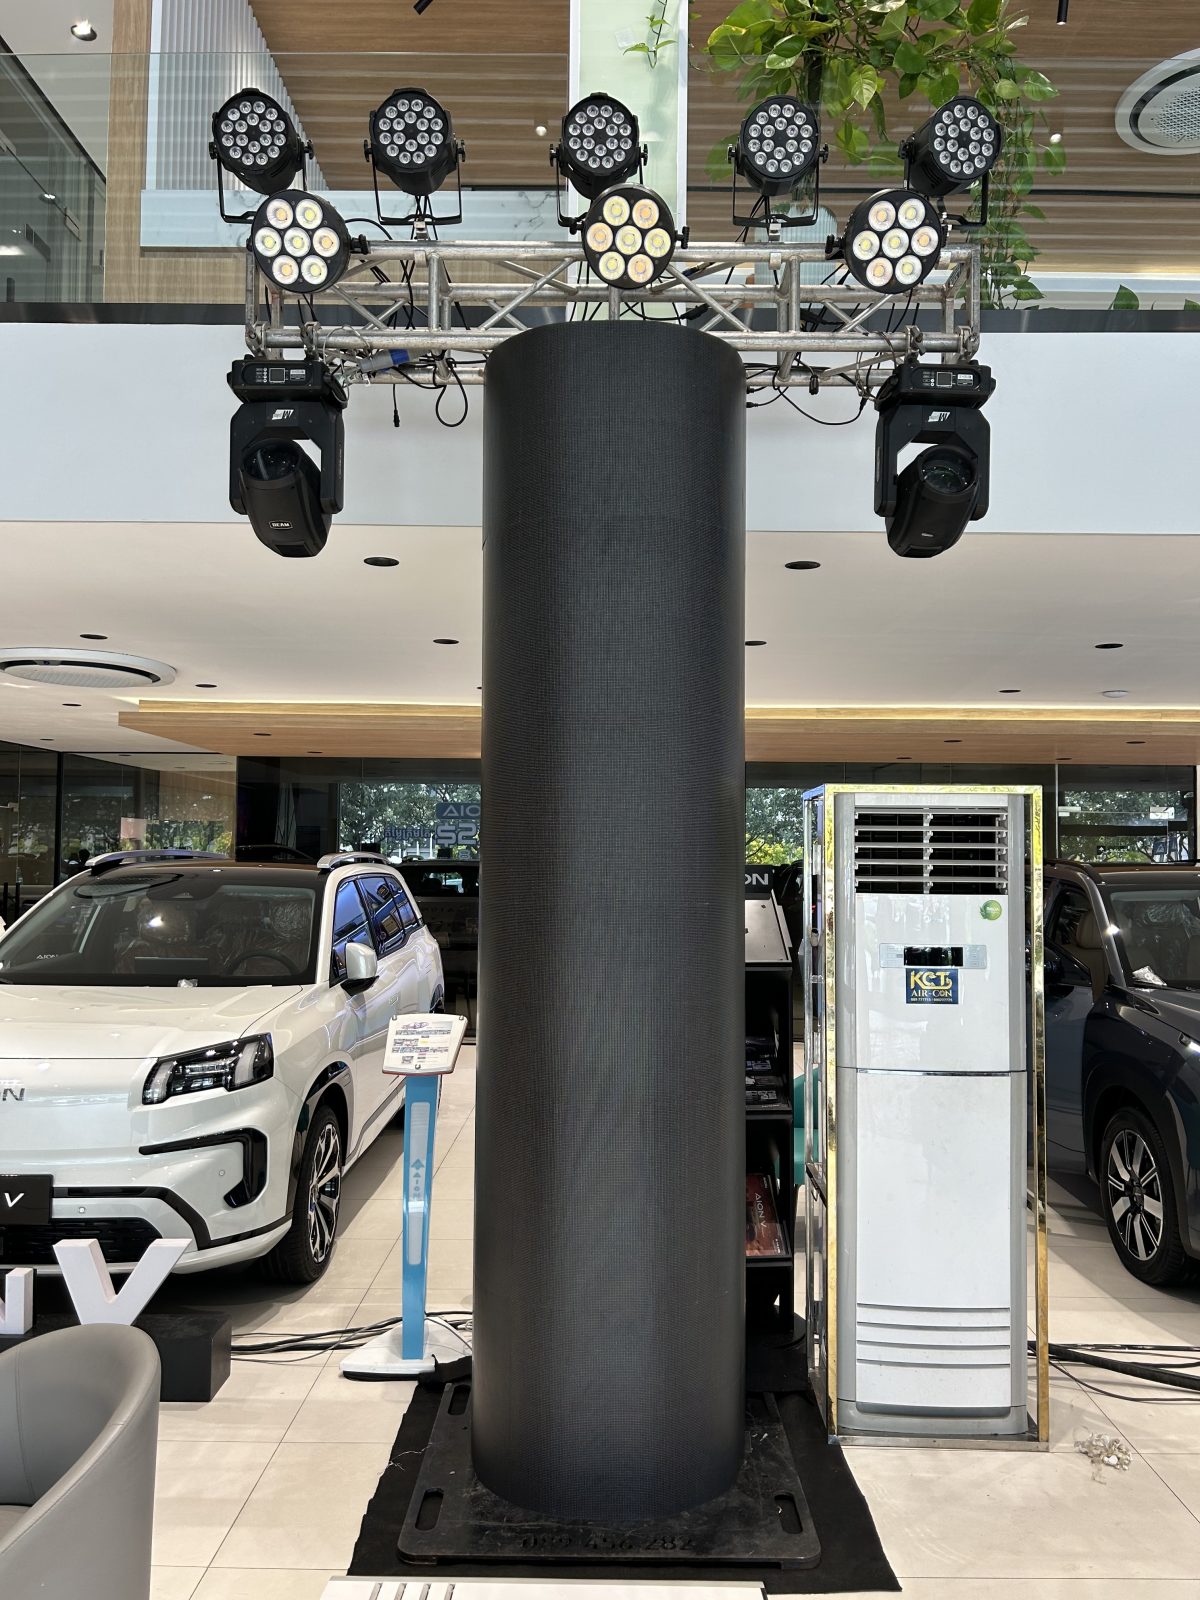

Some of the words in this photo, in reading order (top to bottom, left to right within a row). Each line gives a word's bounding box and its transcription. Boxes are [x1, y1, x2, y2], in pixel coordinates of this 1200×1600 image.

[911, 990, 952, 998] AIR-CON
[4, 1192, 25, 1208] V
[754, 1192, 766, 1219] AION
[53, 1238, 193, 1326] V
